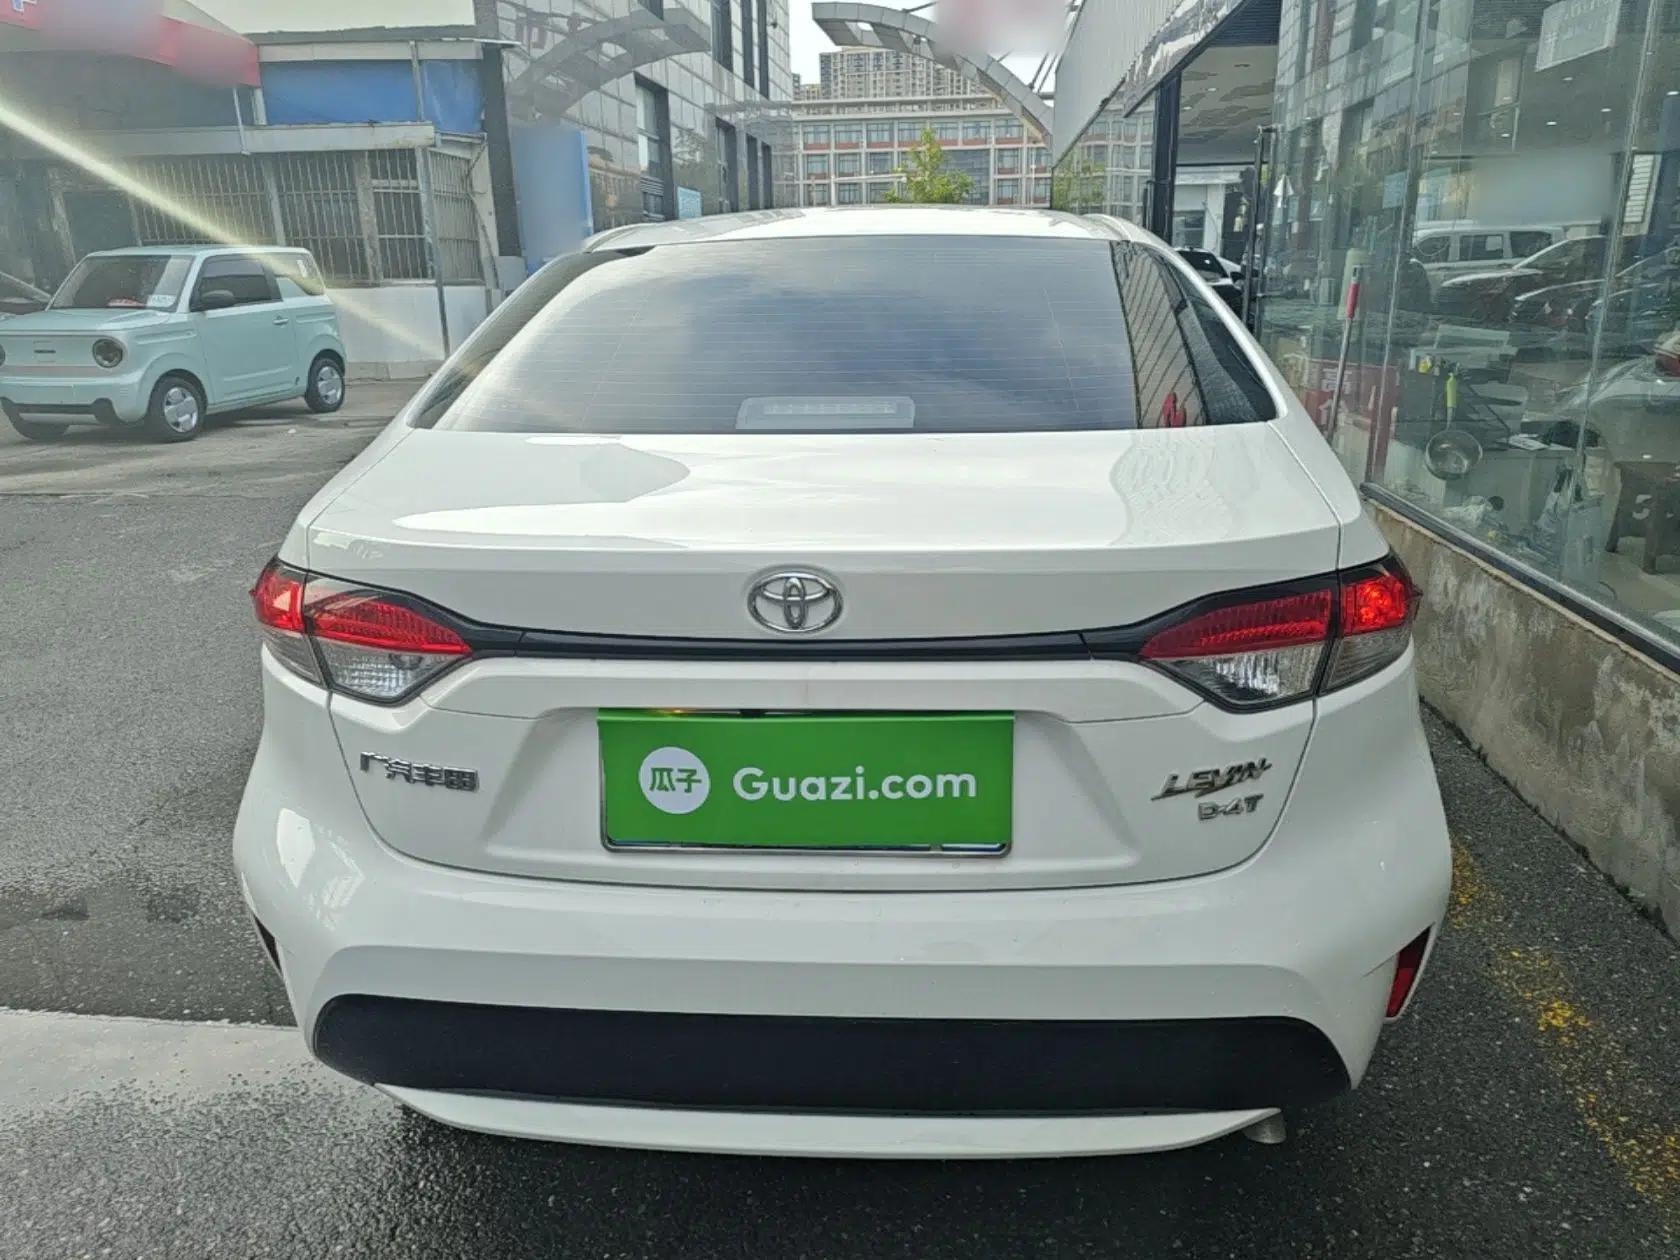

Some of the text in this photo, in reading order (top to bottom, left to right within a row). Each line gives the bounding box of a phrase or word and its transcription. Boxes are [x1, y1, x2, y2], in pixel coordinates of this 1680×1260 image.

[648, 766, 977, 801] 瓜子 Guazi.com
[1150, 757, 1273, 802] LEVIN
[1197, 793, 1264, 821] D-4T
